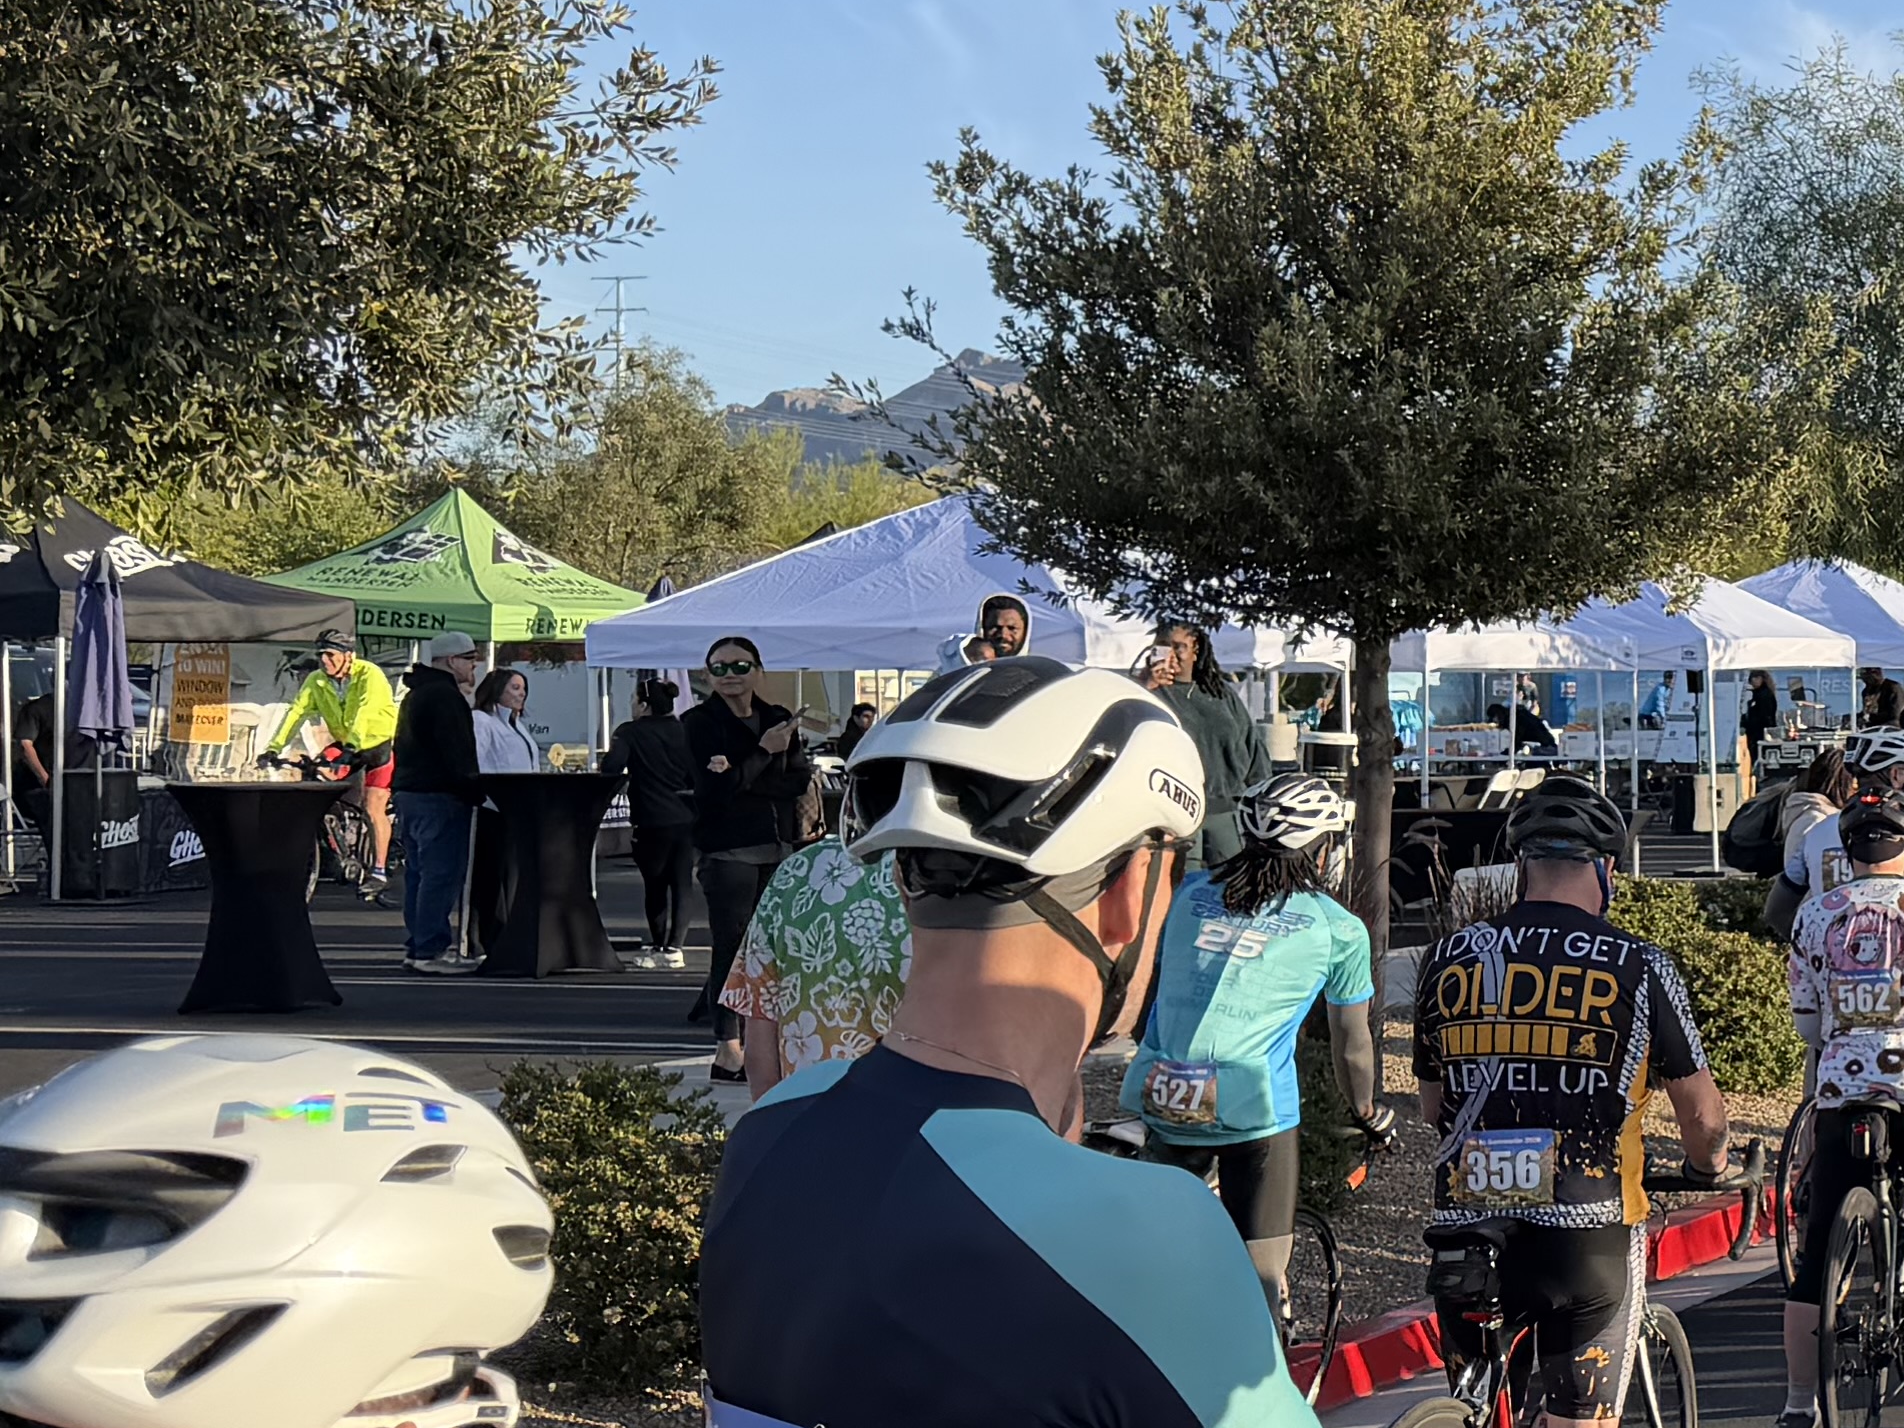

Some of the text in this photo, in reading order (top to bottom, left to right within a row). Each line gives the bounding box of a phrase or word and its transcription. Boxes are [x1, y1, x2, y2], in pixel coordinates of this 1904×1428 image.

[357, 608, 446, 630] DERSEN
[525, 617, 590, 635] RENEW
[1158, 777, 1198, 818] ABUS
[168, 829, 206, 866] GHO
[1193, 921, 1271, 960] 25
[1446, 926, 1559, 959] DON'T
[1563, 931, 1637, 966] GET
[1437, 963, 1619, 1026] OLDER
[1838, 983, 1892, 1014] 562
[1151, 1074, 1205, 1110] 527
[1448, 1062, 1609, 1095] LEVEL UP
[212, 1091, 463, 1139] MET
[1467, 1149, 1541, 1191] 356
